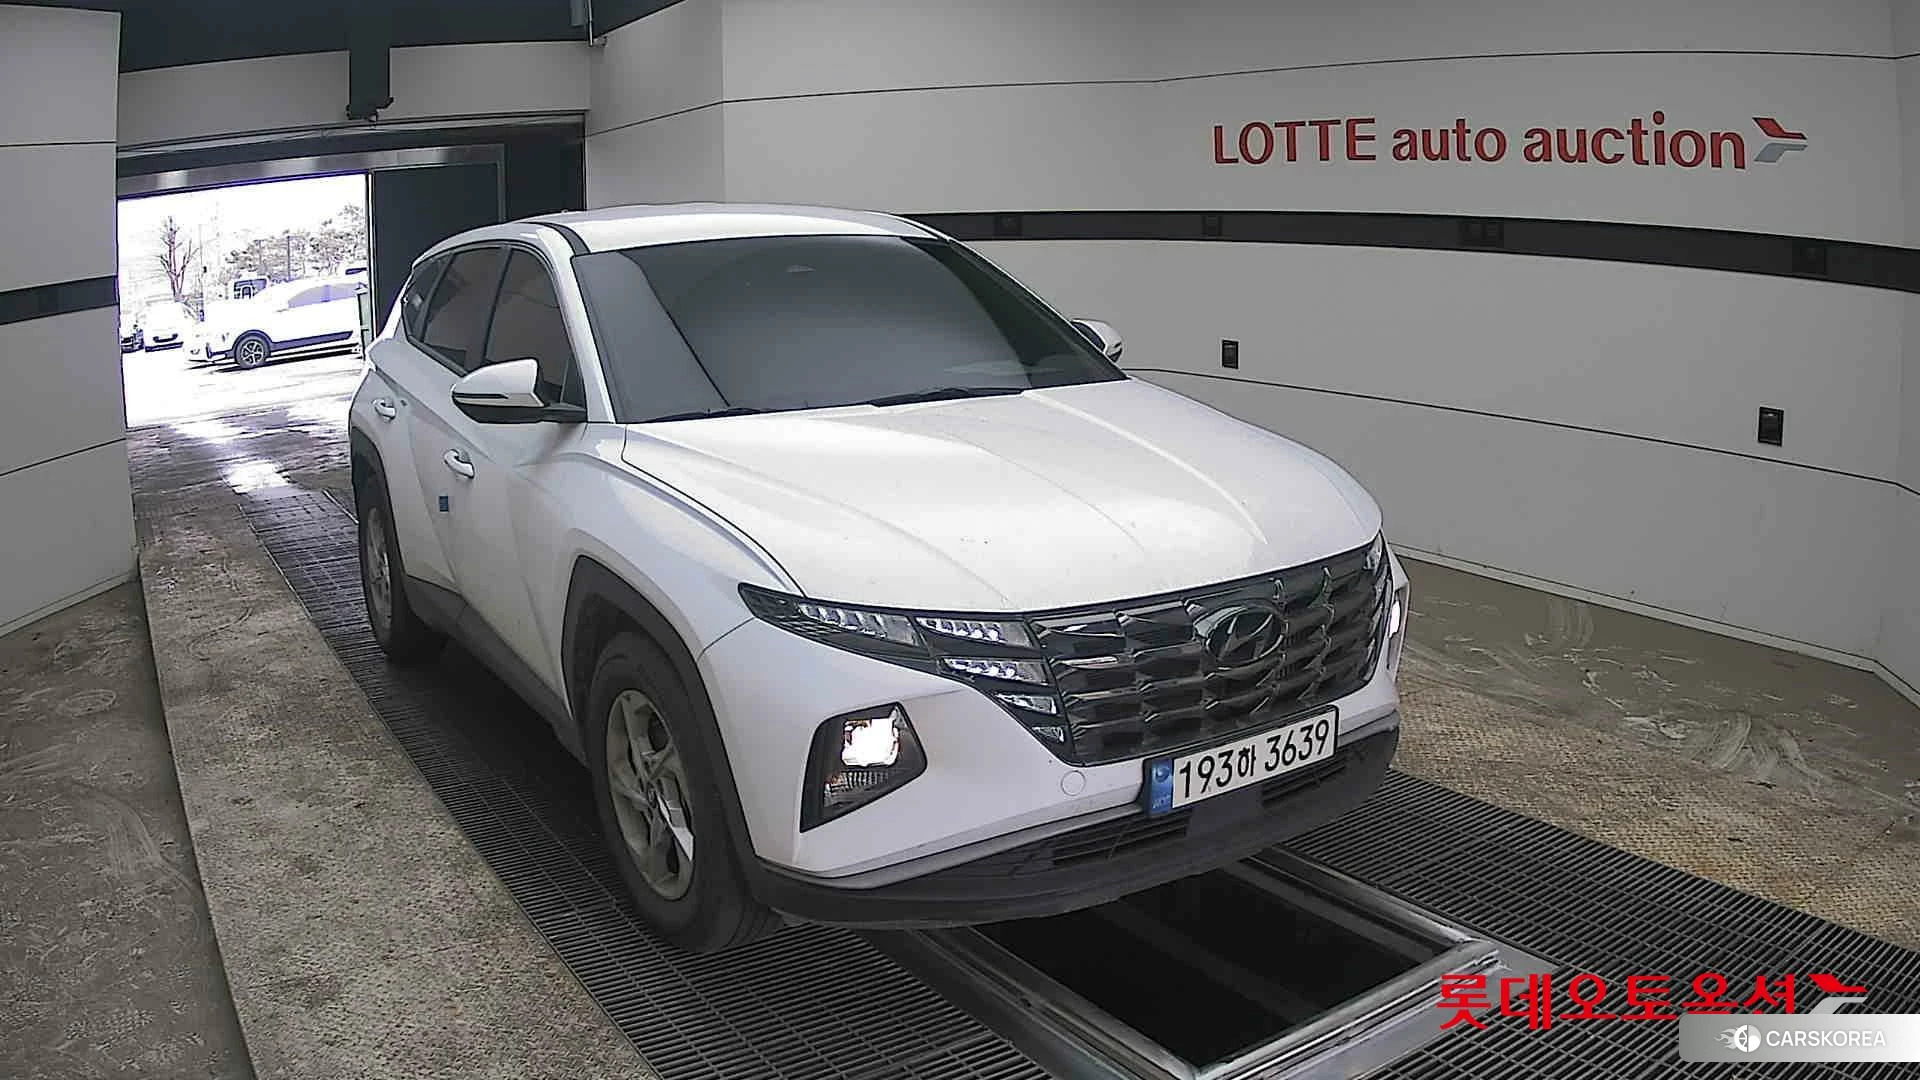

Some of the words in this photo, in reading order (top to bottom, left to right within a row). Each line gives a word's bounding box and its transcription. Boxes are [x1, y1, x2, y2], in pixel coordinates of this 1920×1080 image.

[1214, 117, 1376, 164] LOTTE
[1391, 118, 1506, 162] auto
[1523, 110, 1746, 168] auction
[1179, 744, 1257, 799] 193하
[1264, 719, 1330, 772] 3639
